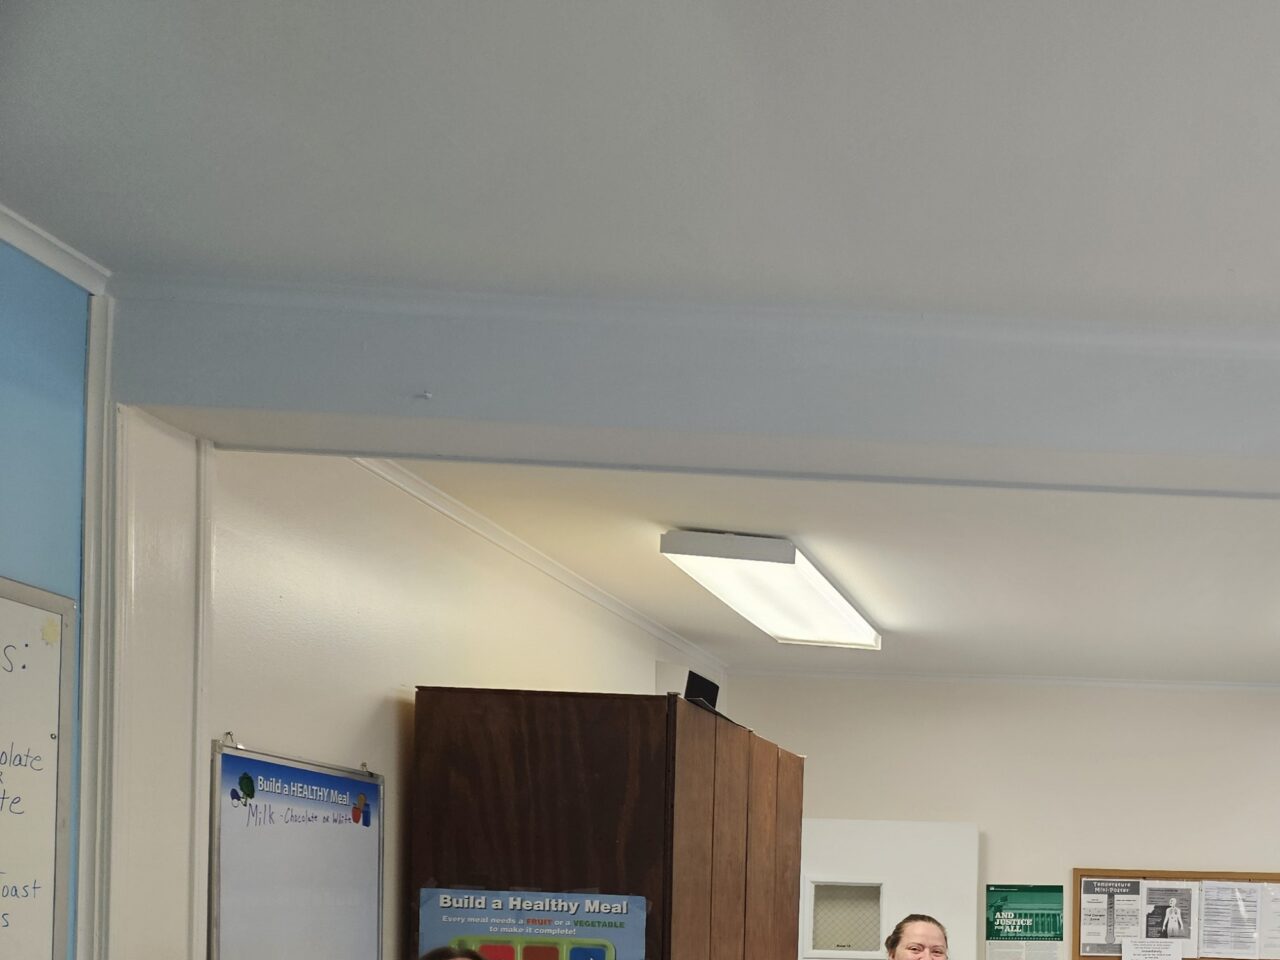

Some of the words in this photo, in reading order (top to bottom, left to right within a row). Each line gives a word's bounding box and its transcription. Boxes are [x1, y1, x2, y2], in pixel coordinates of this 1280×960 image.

[257, 776, 282, 794] Build
[284, 784, 289, 795] a
[290, 782, 330, 802] HEALTHY
[330, 790, 350, 805] Meal
[246, 803, 276, 827] Milk
[332, 811, 352, 824] White
[439, 894, 487, 910] Build
[492, 899, 503, 910] a
[508, 897, 580, 916] Healthy
[584, 899, 629, 915] Meal
[441, 915, 466, 924] Every
[573, 919, 625, 928] VEGETABLE
[1004, 925, 1022, 933] ALL
[533, 927, 577, 936] complete!
